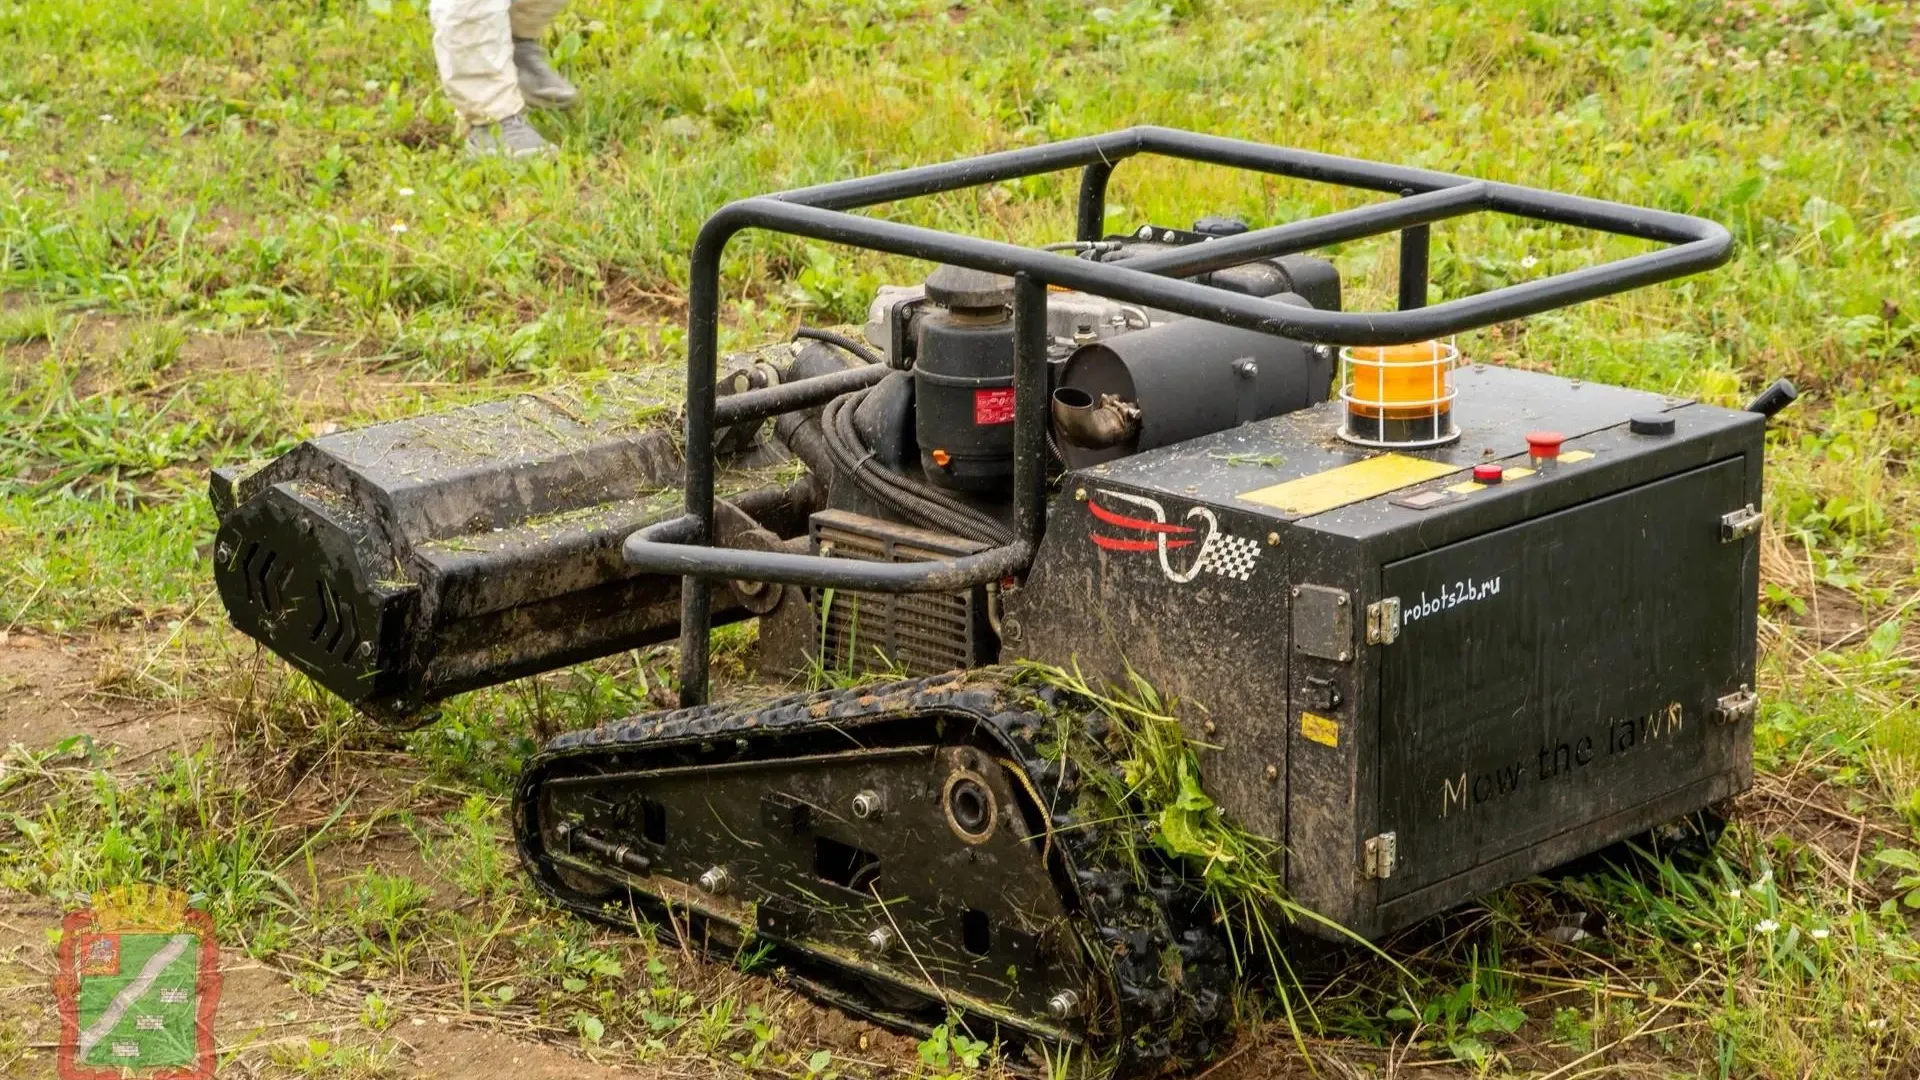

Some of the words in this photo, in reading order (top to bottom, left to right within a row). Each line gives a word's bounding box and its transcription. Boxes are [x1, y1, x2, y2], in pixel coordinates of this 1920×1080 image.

[1403, 576, 1501, 625] robots2b.ru
[1442, 763, 1521, 817] Mow
[1537, 735, 1593, 782] the
